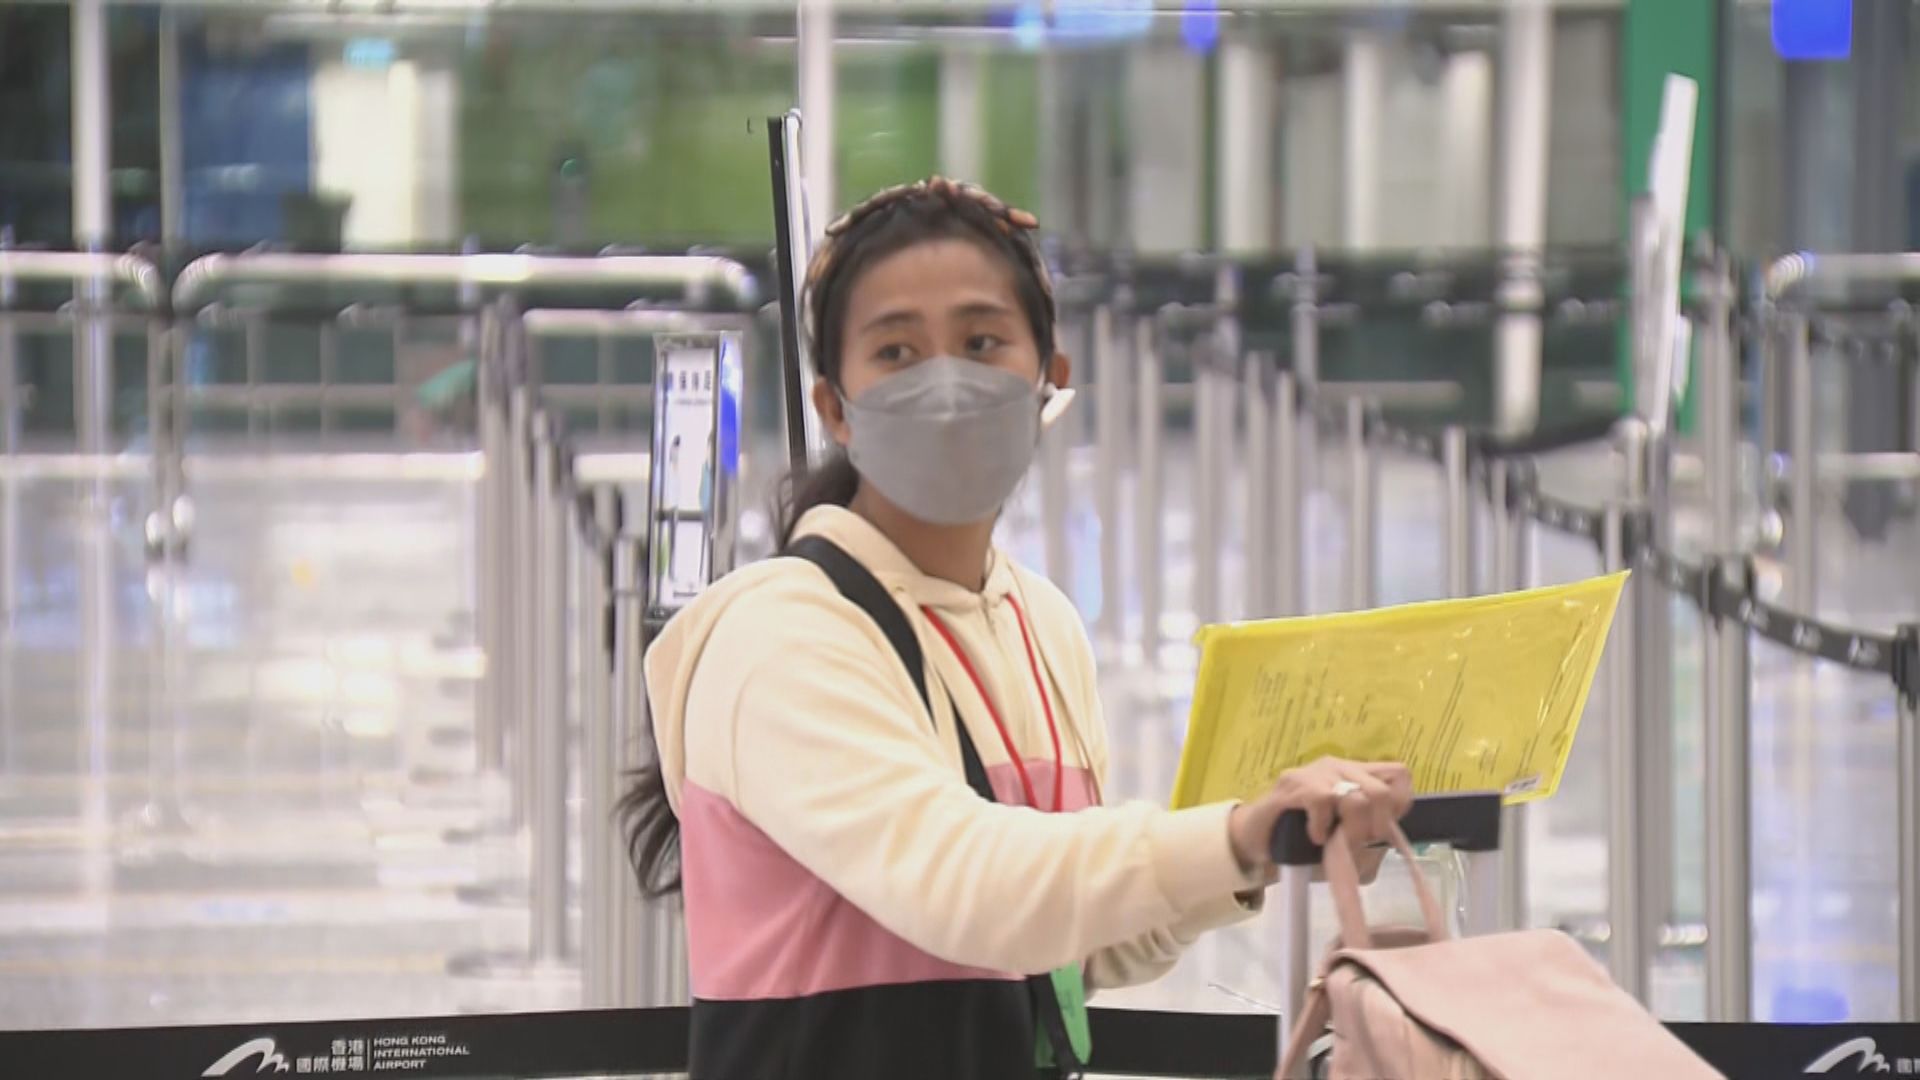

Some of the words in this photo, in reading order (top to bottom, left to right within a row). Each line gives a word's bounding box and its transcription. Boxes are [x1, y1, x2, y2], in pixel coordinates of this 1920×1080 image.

[374, 1037, 408, 1046] HONG
[411, 1035, 445, 1045] KONG
[331, 1039, 364, 1055] 香港
[374, 1046, 470, 1058] INTERNATIONAL
[296, 1056, 364, 1073] 國際機場
[374, 1059, 427, 1070] AIRPORT
